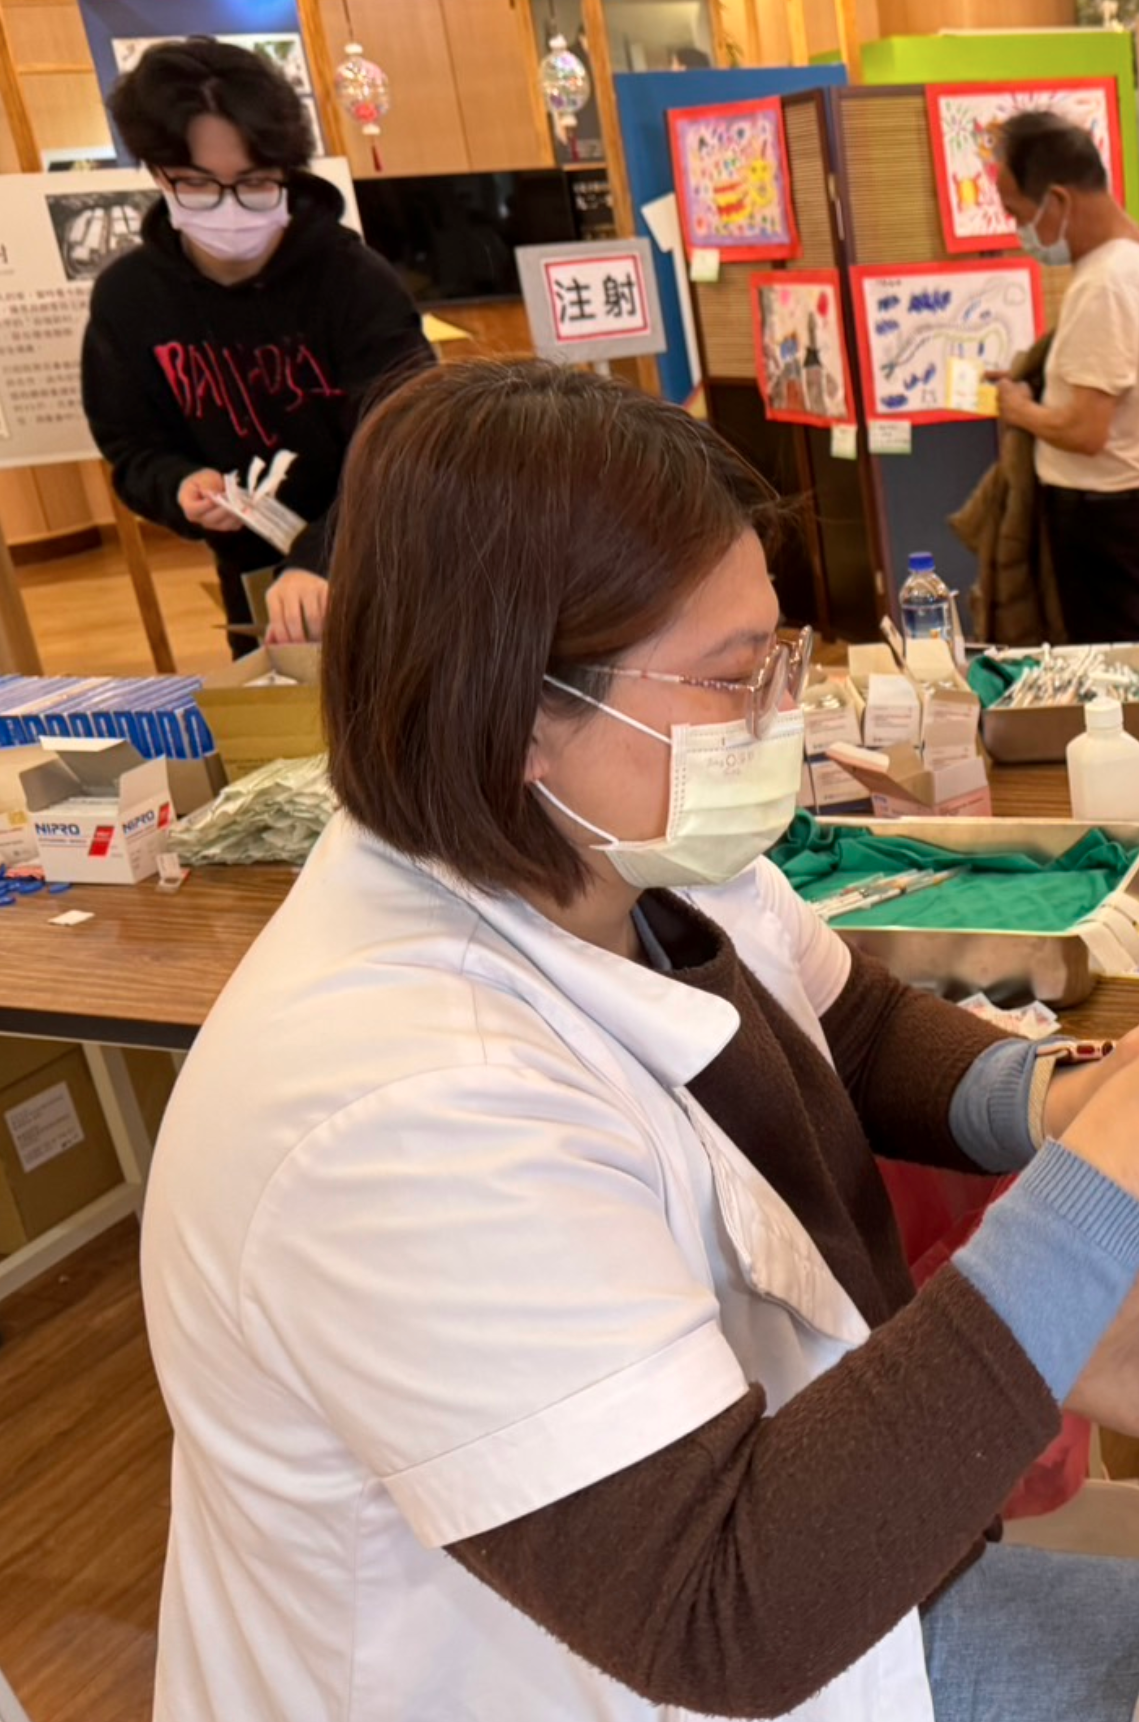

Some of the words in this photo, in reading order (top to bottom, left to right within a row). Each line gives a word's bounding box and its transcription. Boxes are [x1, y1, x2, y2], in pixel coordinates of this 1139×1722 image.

[554, 272, 636, 324] 注射
[35, 823, 80, 836] NIPRO
[122, 810, 155, 834] NIPRO
